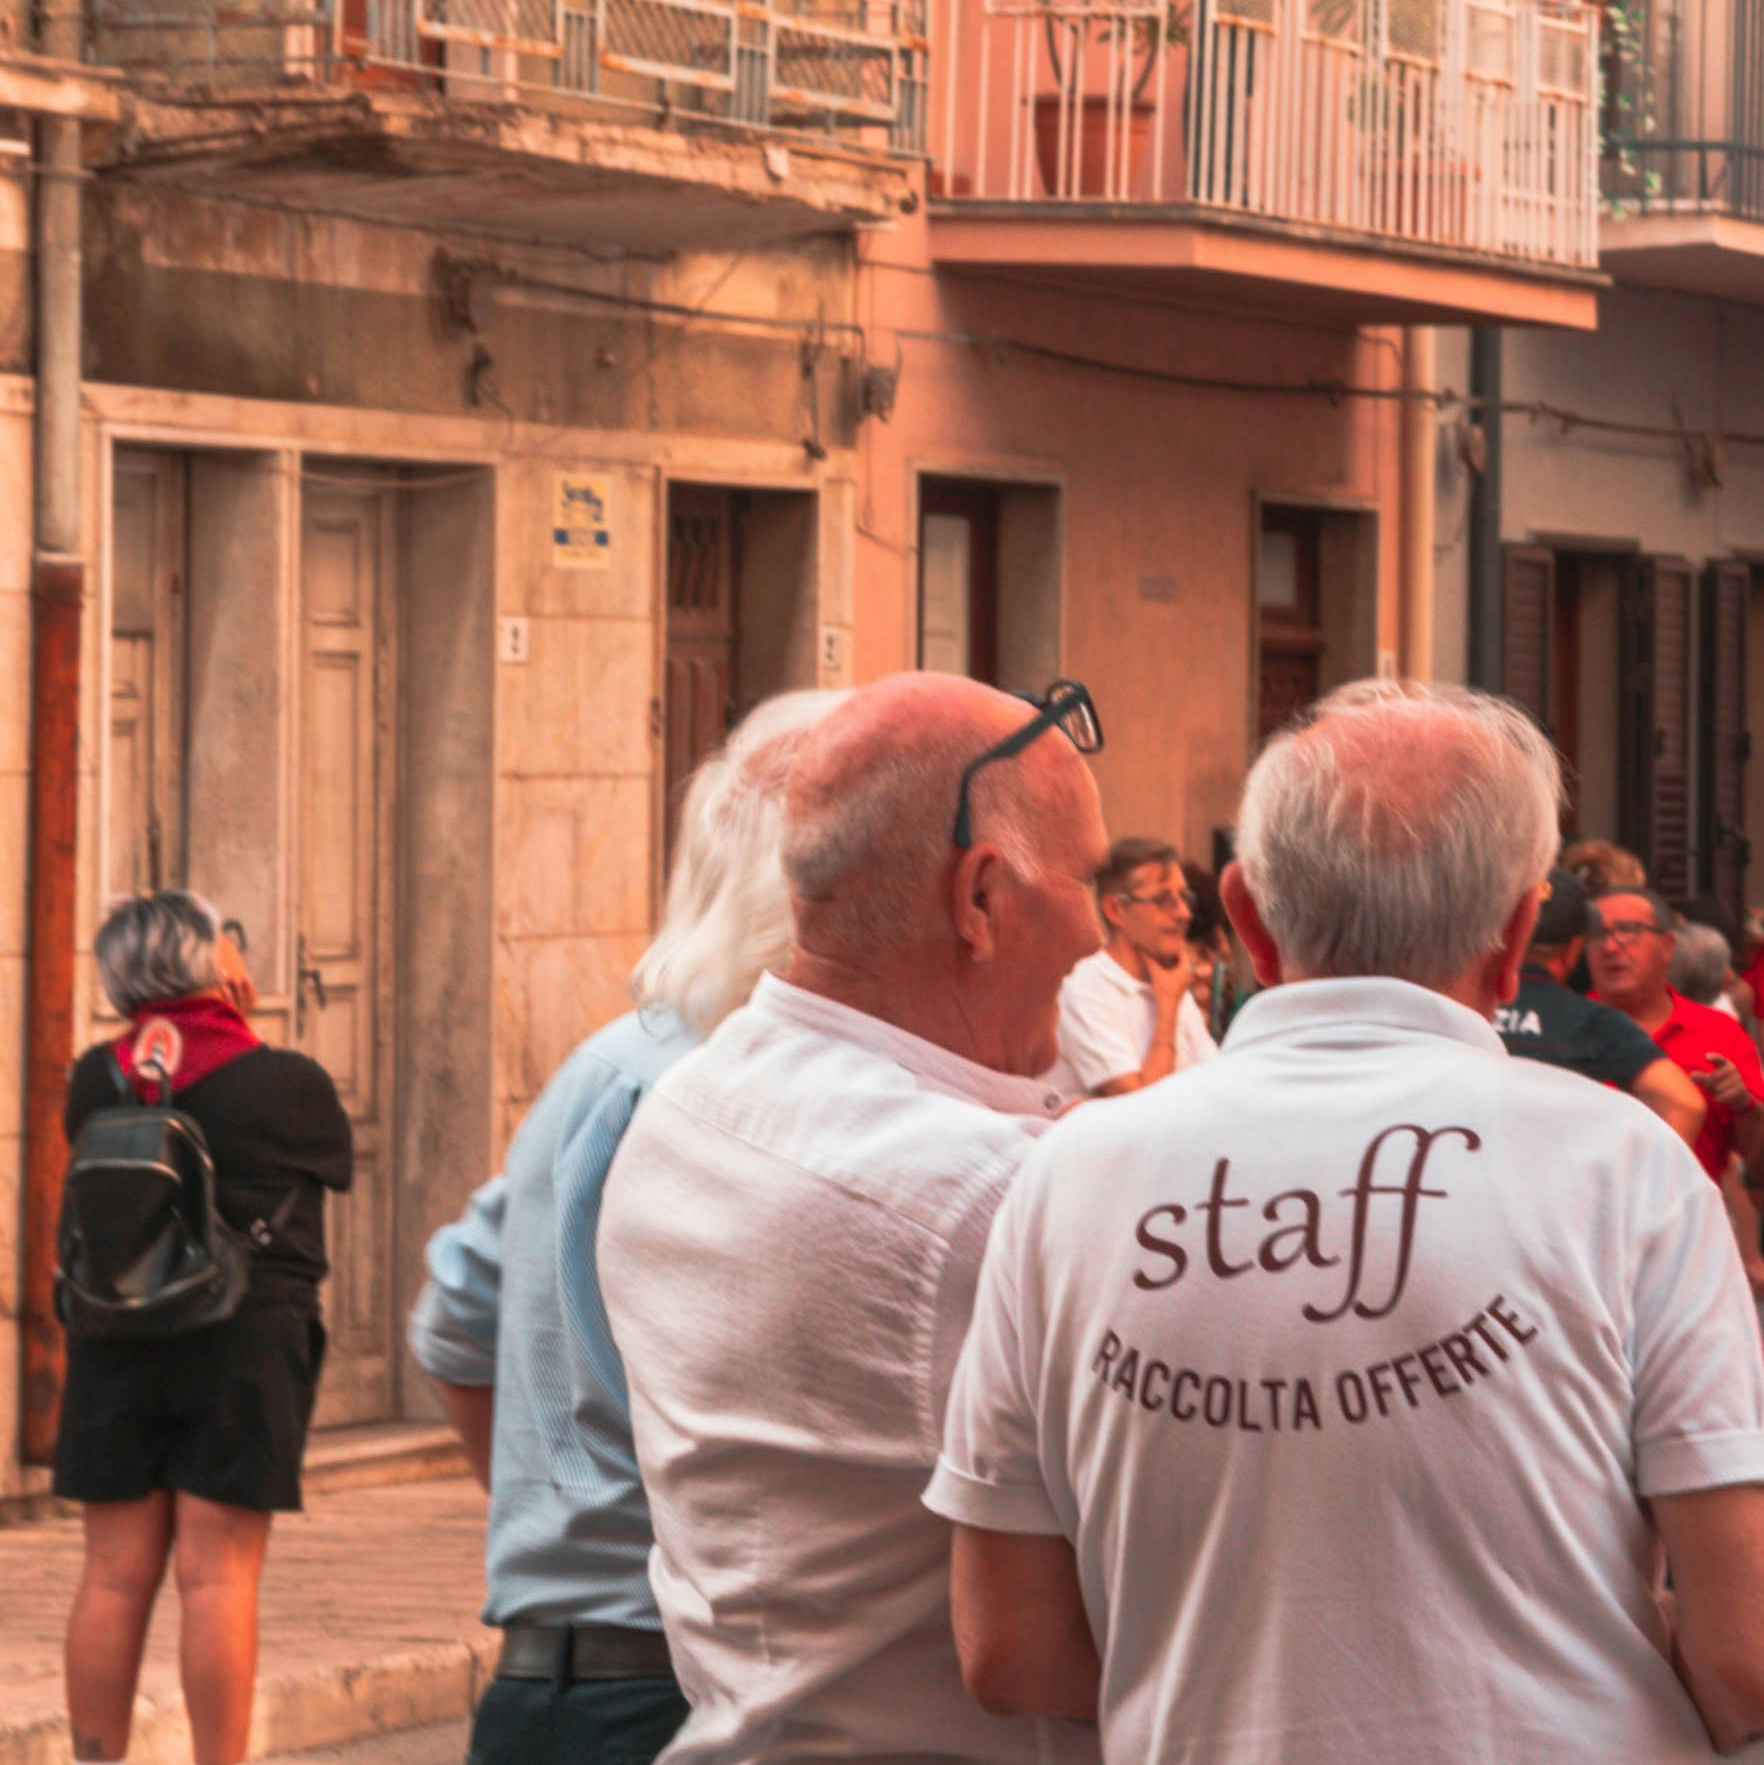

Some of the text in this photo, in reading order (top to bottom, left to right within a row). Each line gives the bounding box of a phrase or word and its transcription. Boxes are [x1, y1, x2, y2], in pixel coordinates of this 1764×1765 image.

[1132, 1123, 1483, 1324] staff
[1091, 1293, 1539, 1432] RACCOLTA OFFERTE
